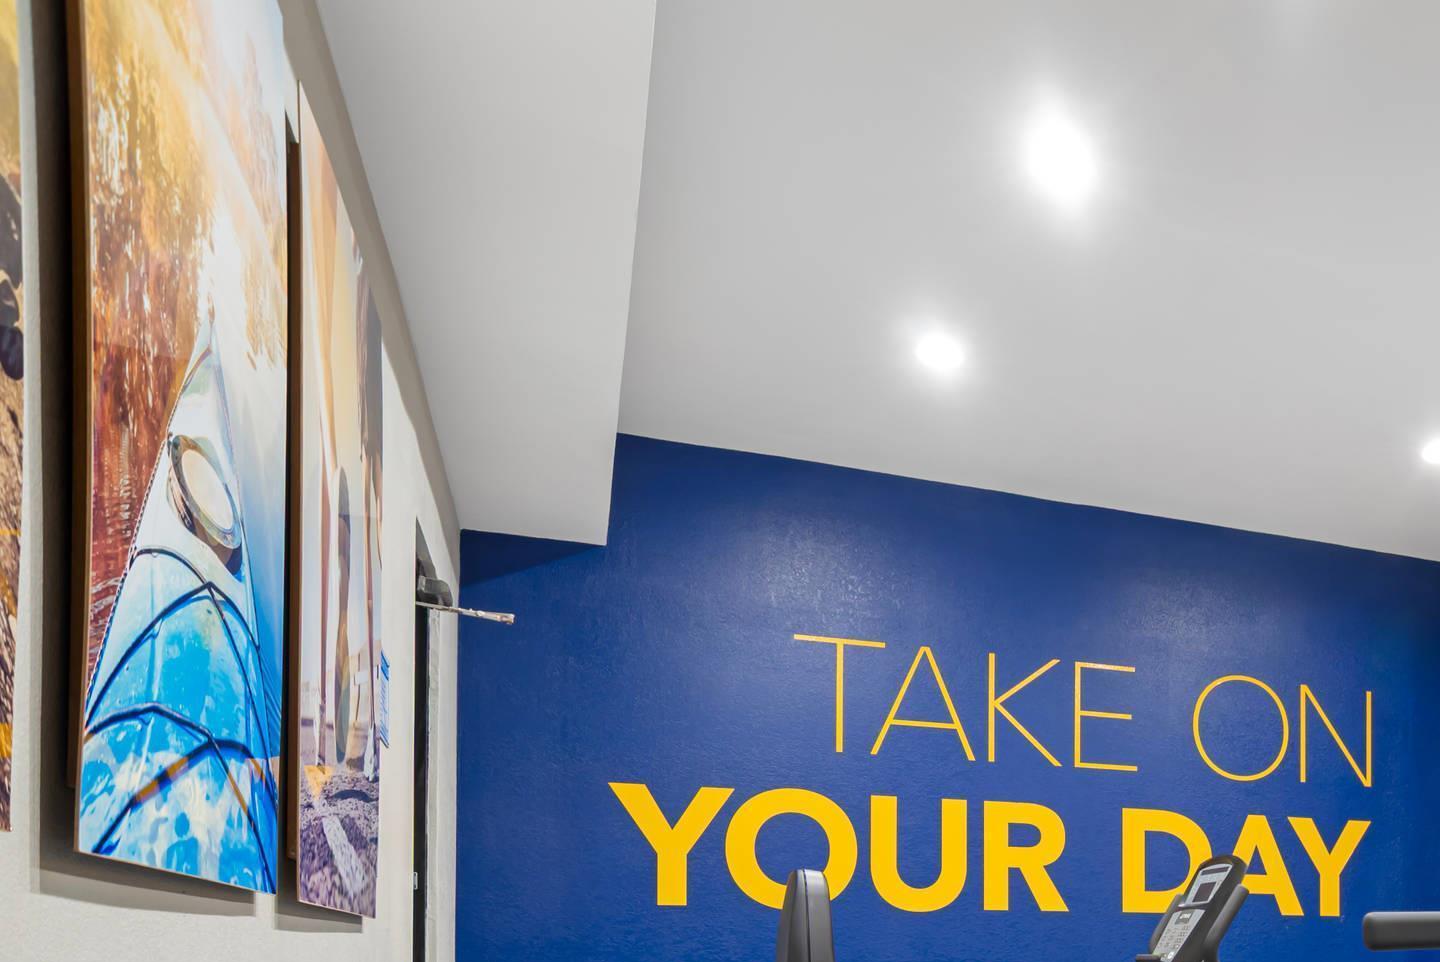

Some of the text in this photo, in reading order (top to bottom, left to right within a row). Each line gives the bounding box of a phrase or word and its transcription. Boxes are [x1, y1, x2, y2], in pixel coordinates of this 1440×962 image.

[793, 634, 1373, 788] TAKE ON
[607, 782, 1372, 918] YOUR DAY
